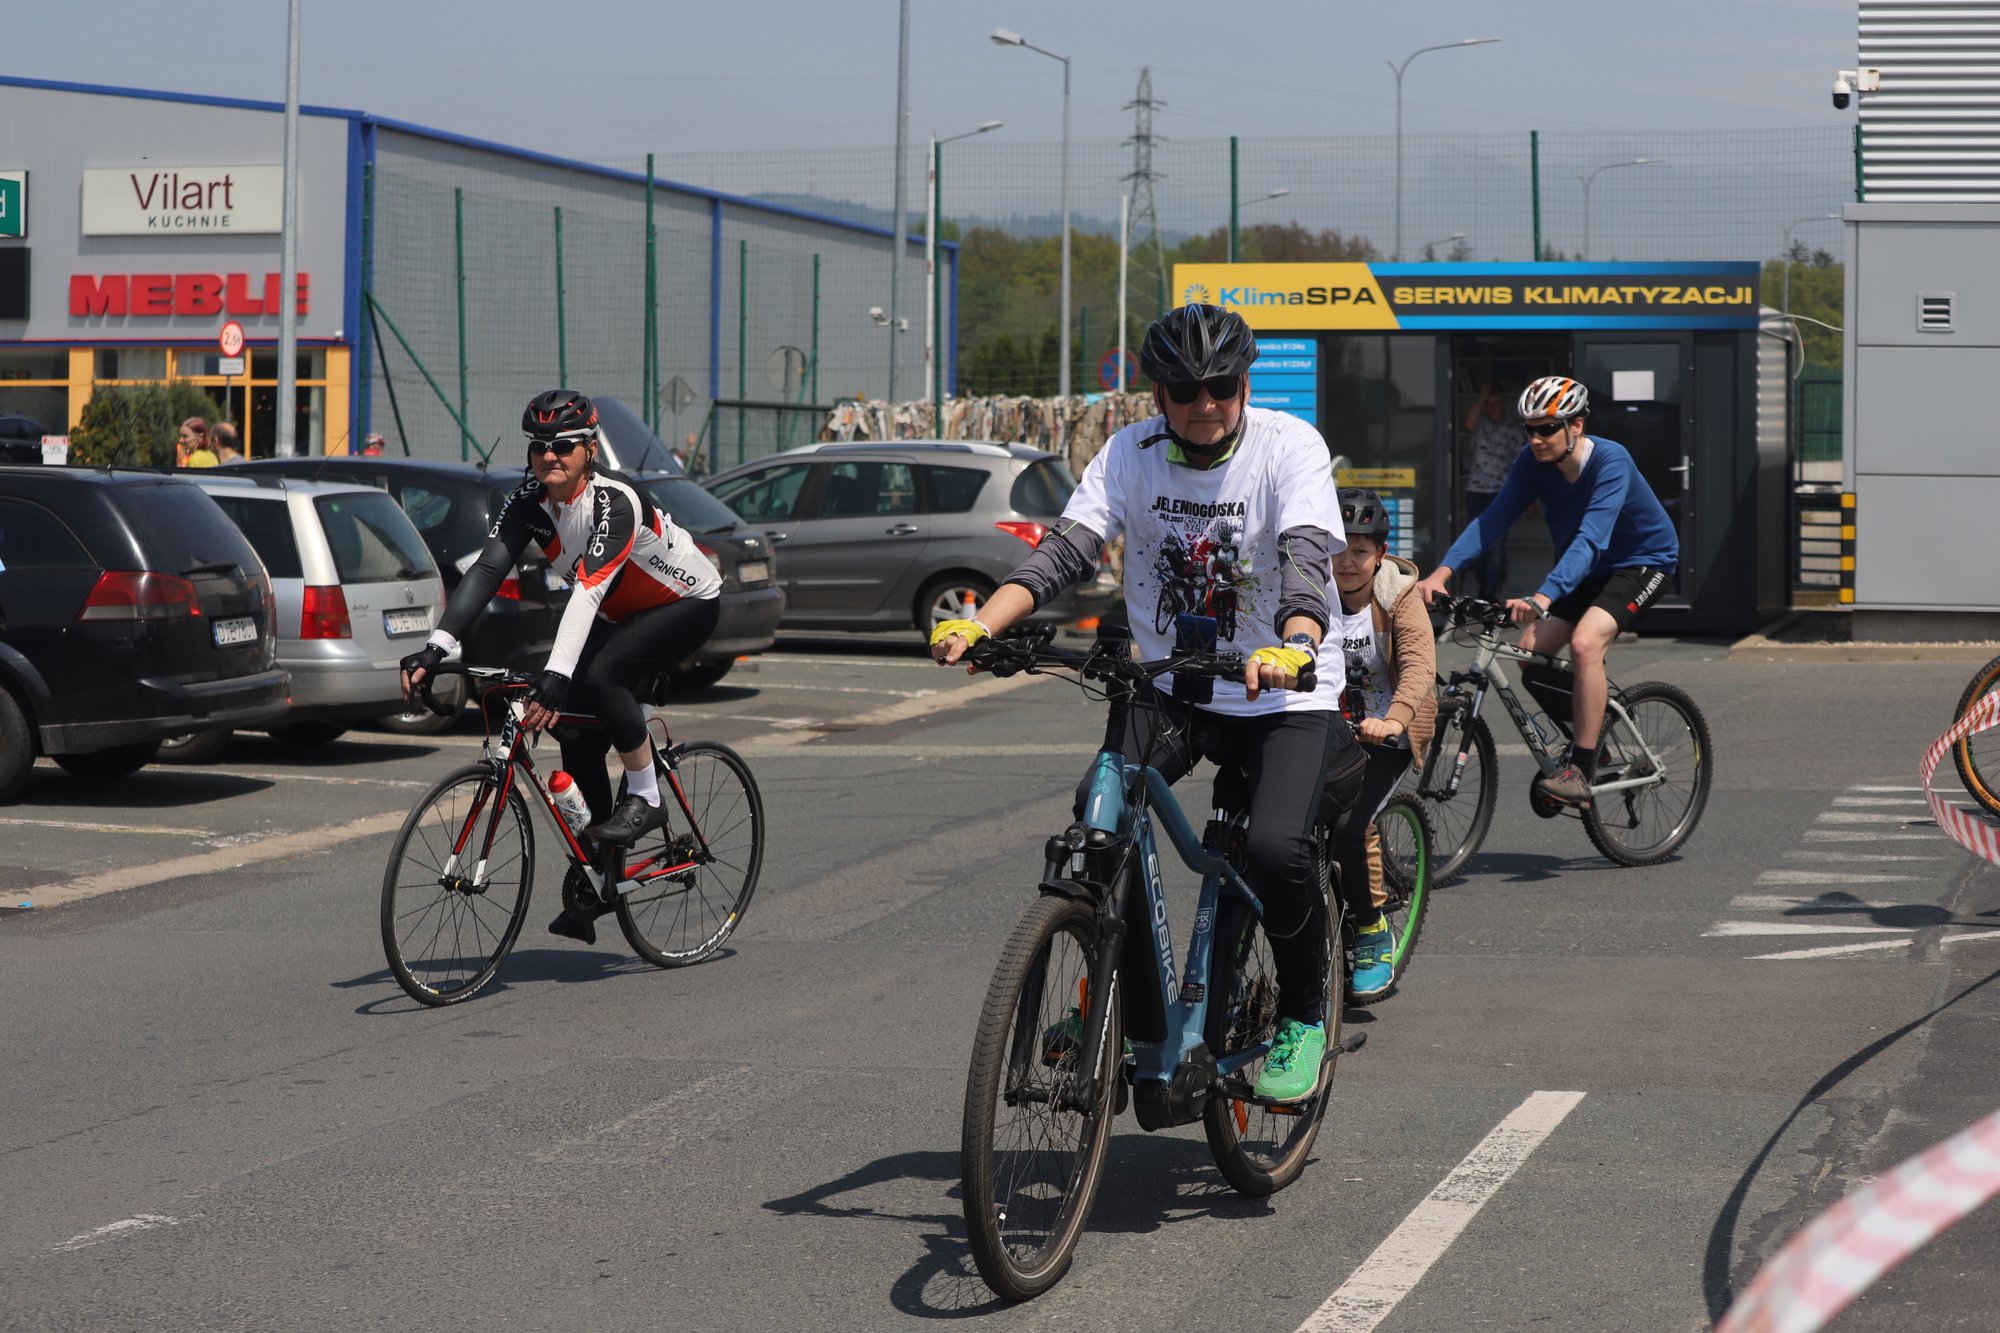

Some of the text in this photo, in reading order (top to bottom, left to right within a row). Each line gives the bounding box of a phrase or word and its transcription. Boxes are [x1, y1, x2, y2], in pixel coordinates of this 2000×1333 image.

[131, 173, 234, 210] Vilart
[148, 215, 231, 228] KUCHNIE
[69, 273, 310, 316] MEBLE
[1220, 287, 1376, 306] KlimaSPA
[1393, 286, 1752, 305] SERWIS KLIMATYZACJI
[648, 554, 697, 587] DANIELO
[1147, 852, 1179, 1006] ECOBIKE
